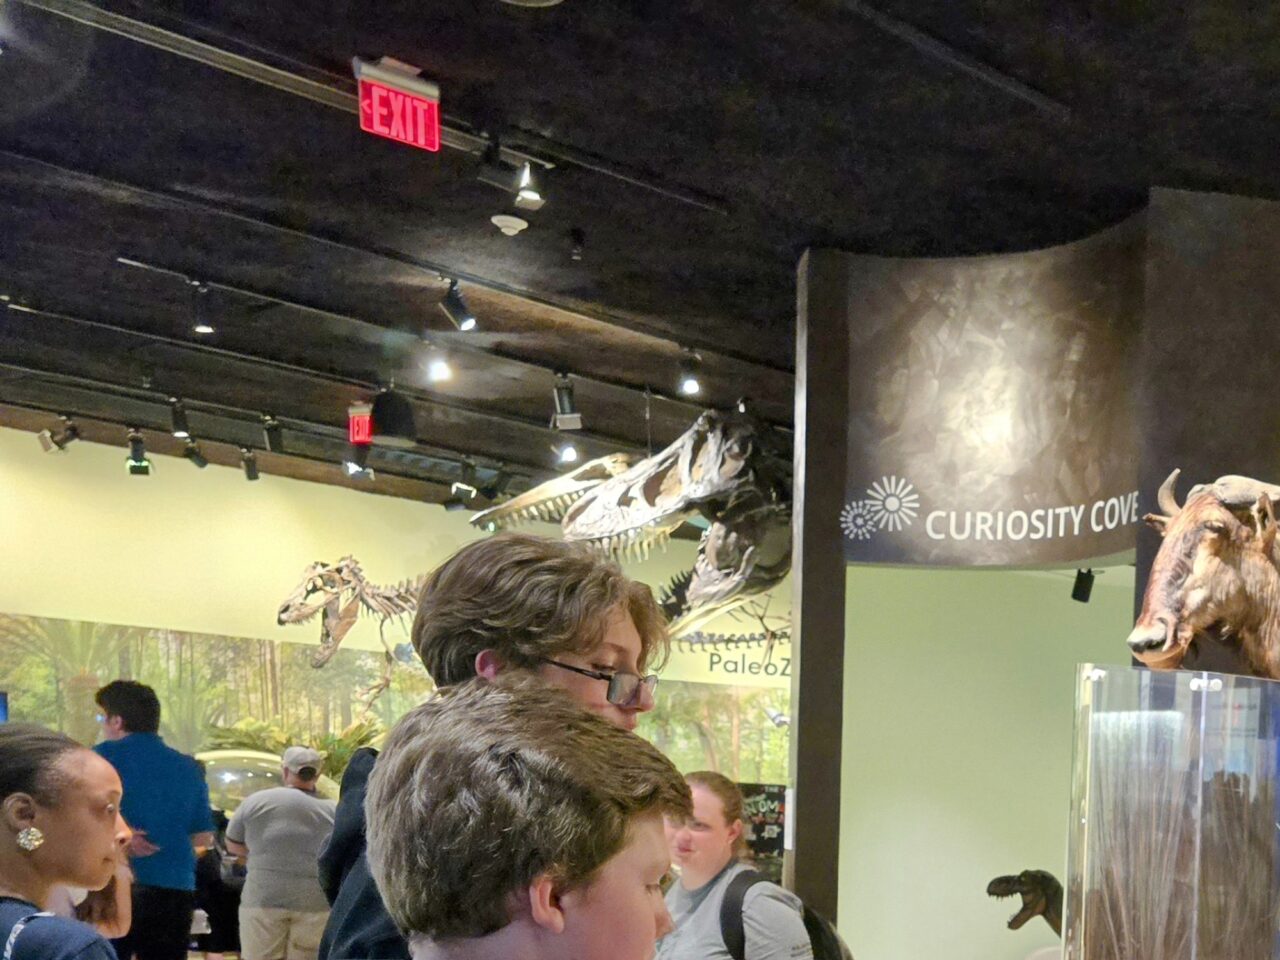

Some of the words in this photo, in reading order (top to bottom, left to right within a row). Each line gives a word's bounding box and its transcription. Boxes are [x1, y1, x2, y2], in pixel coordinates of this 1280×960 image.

[372, 86, 428, 145] EXIT
[925, 504, 1085, 541] CURIOSITY
[1090, 490, 1139, 533] COVE
